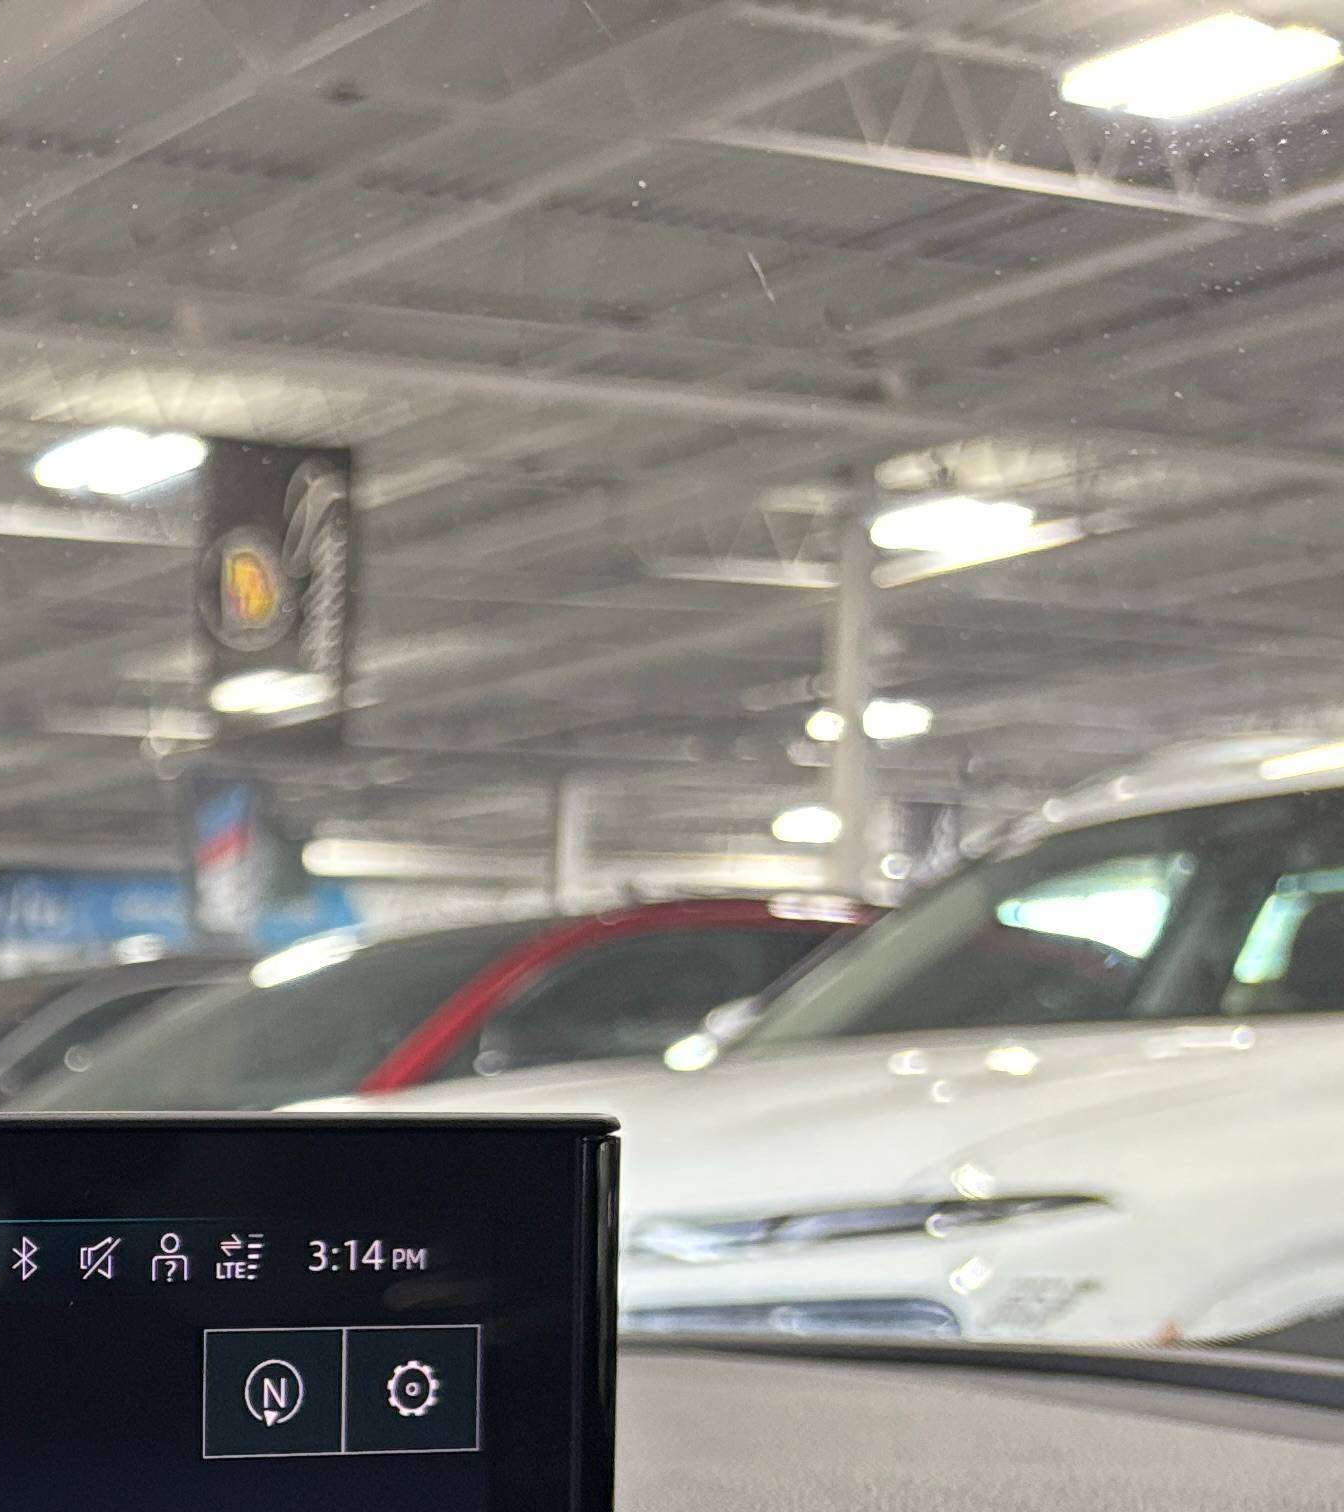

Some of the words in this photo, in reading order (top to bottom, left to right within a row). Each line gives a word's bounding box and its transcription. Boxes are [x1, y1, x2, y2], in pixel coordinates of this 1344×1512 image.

[308, 1239, 386, 1272] 3:14
[392, 1248, 429, 1271] PM
[215, 1262, 247, 1280] LTE
